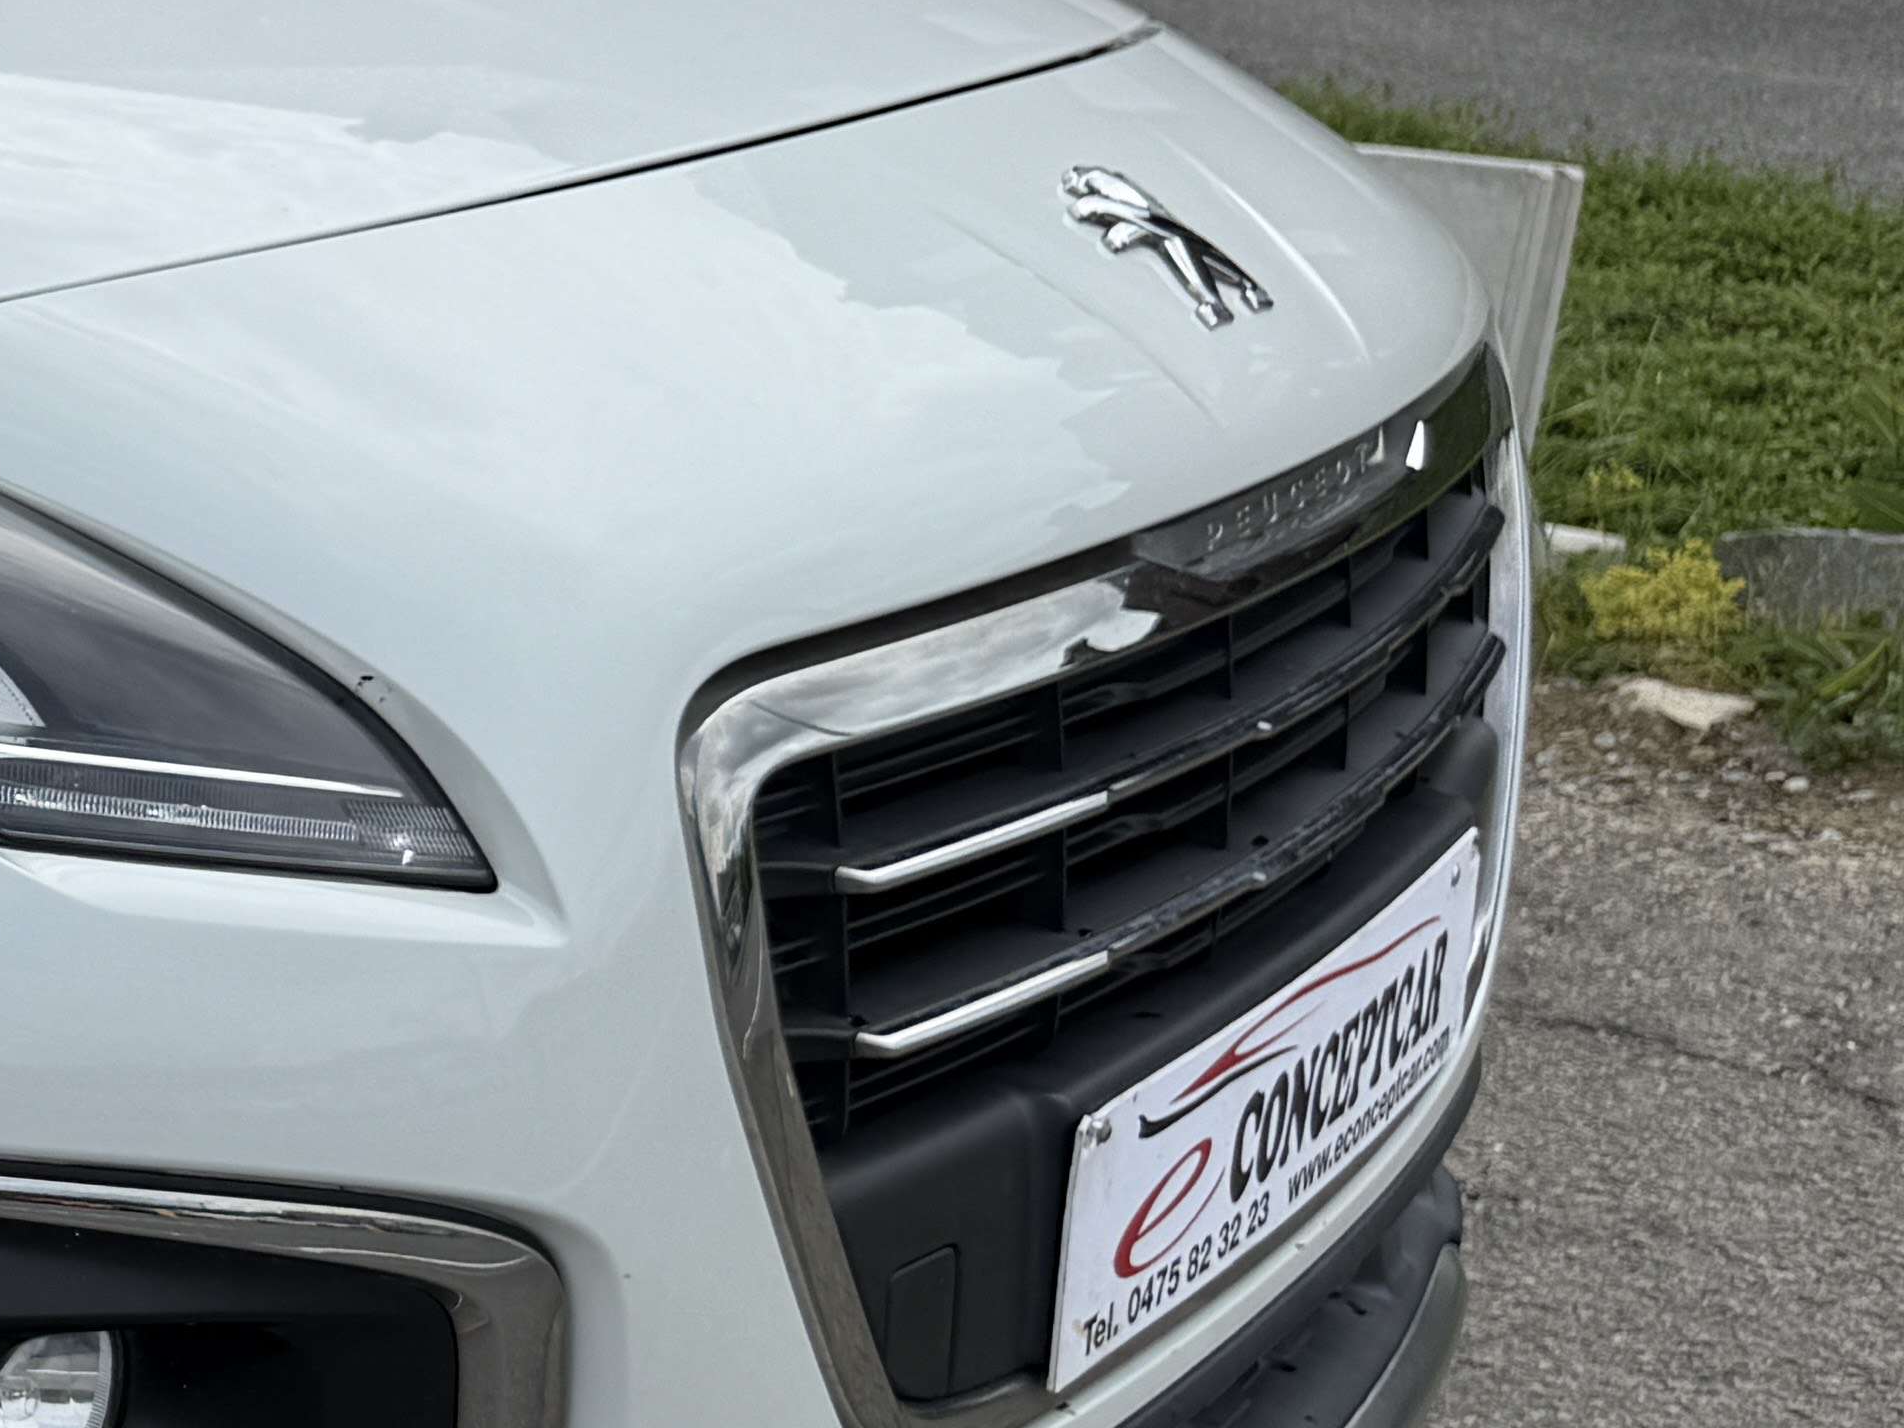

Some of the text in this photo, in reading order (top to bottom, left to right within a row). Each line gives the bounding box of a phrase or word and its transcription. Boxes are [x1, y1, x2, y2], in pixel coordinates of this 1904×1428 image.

[1082, 1024, 1451, 1356] Tel. 0475 82 32 23 www.econceptcar.com
[1229, 929, 1448, 1204] CONCEPTCAR
